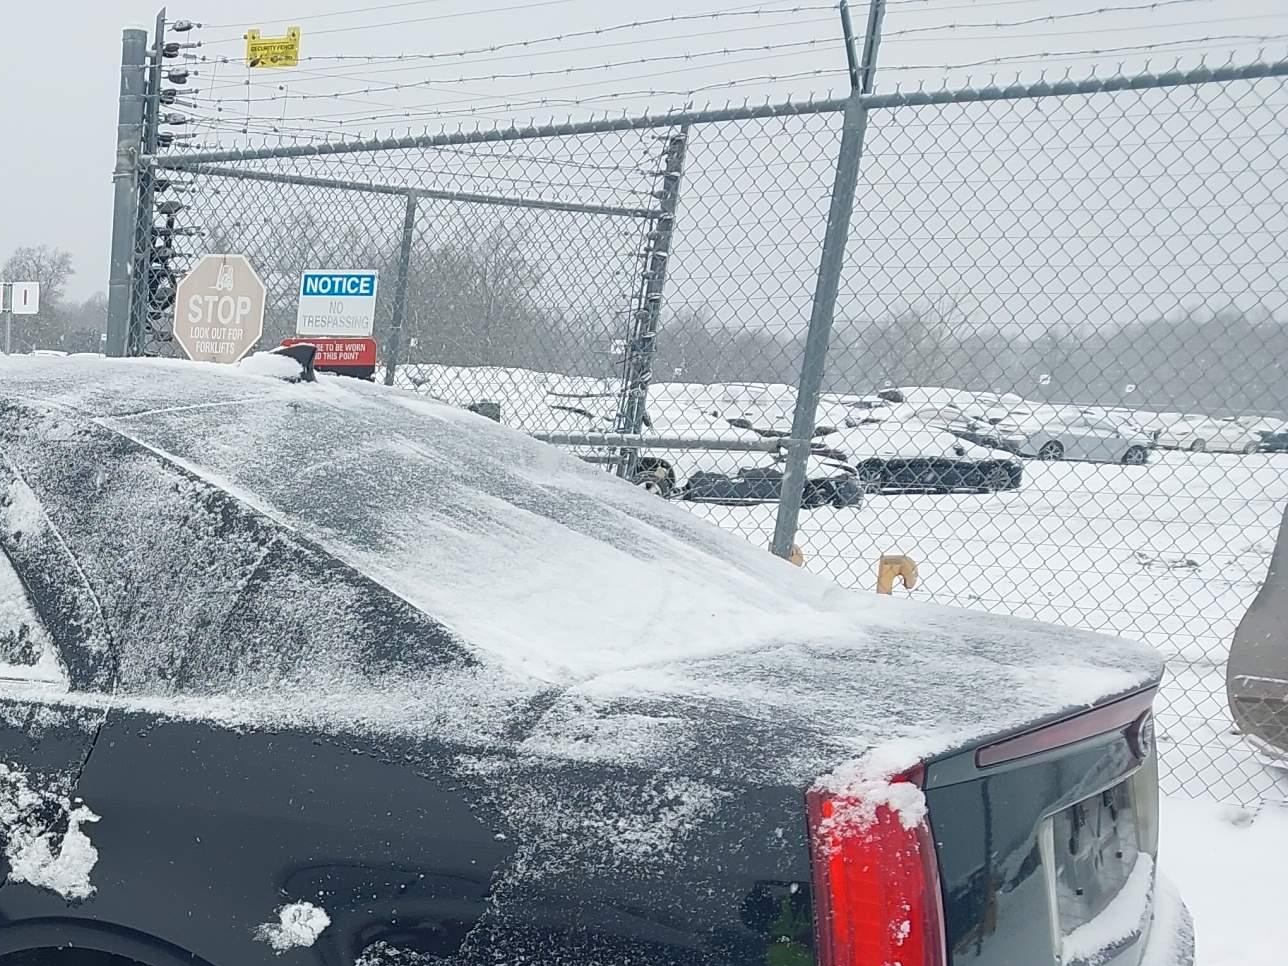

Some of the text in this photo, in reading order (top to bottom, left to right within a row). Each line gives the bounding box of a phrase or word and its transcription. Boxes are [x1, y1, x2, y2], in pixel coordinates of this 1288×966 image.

[306, 276, 372, 294] NOTICE
[188, 294, 251, 325] STOP
[329, 301, 344, 314] NO
[302, 314, 369, 329] TRESPASSING
[190, 326, 244, 340] LOOK OUT FOR
[195, 341, 235, 355] FORKLIFTS
[325, 343, 334, 352] TO
[335, 343, 344, 352] BE
[345, 343, 366, 352] WORN
[323, 352, 338, 361] THIS
[338, 352, 360, 361] POINT
